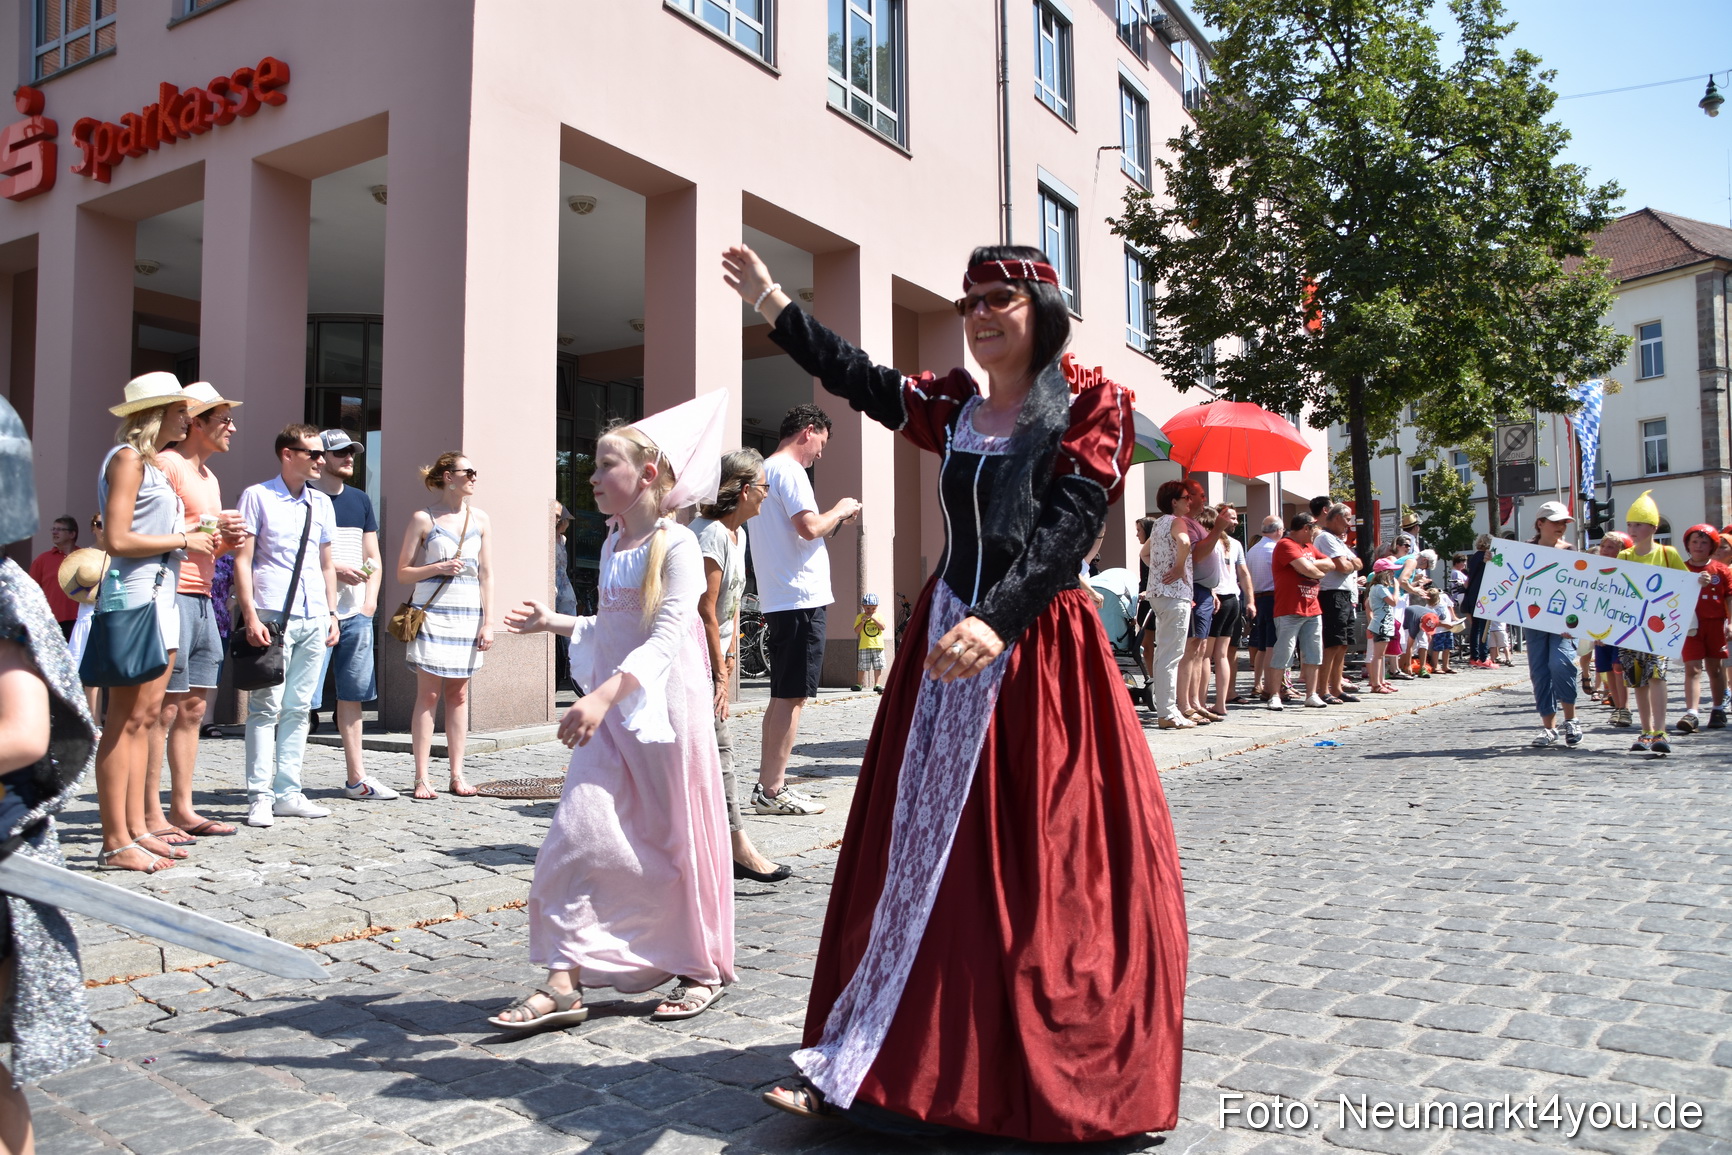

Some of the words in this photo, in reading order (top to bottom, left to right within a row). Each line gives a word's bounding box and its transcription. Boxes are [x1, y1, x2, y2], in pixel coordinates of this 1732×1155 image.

[70, 56, 290, 184] Sparkasse
[1507, 451, 1526, 460] ZONE
[1476, 562, 1519, 615] gesund
[1525, 582, 1541, 596] im
[1555, 569, 1637, 599] Grundschule
[1572, 593, 1588, 613] St.
[1594, 597, 1637, 626] Marien
[1666, 594, 1682, 647] bunt
